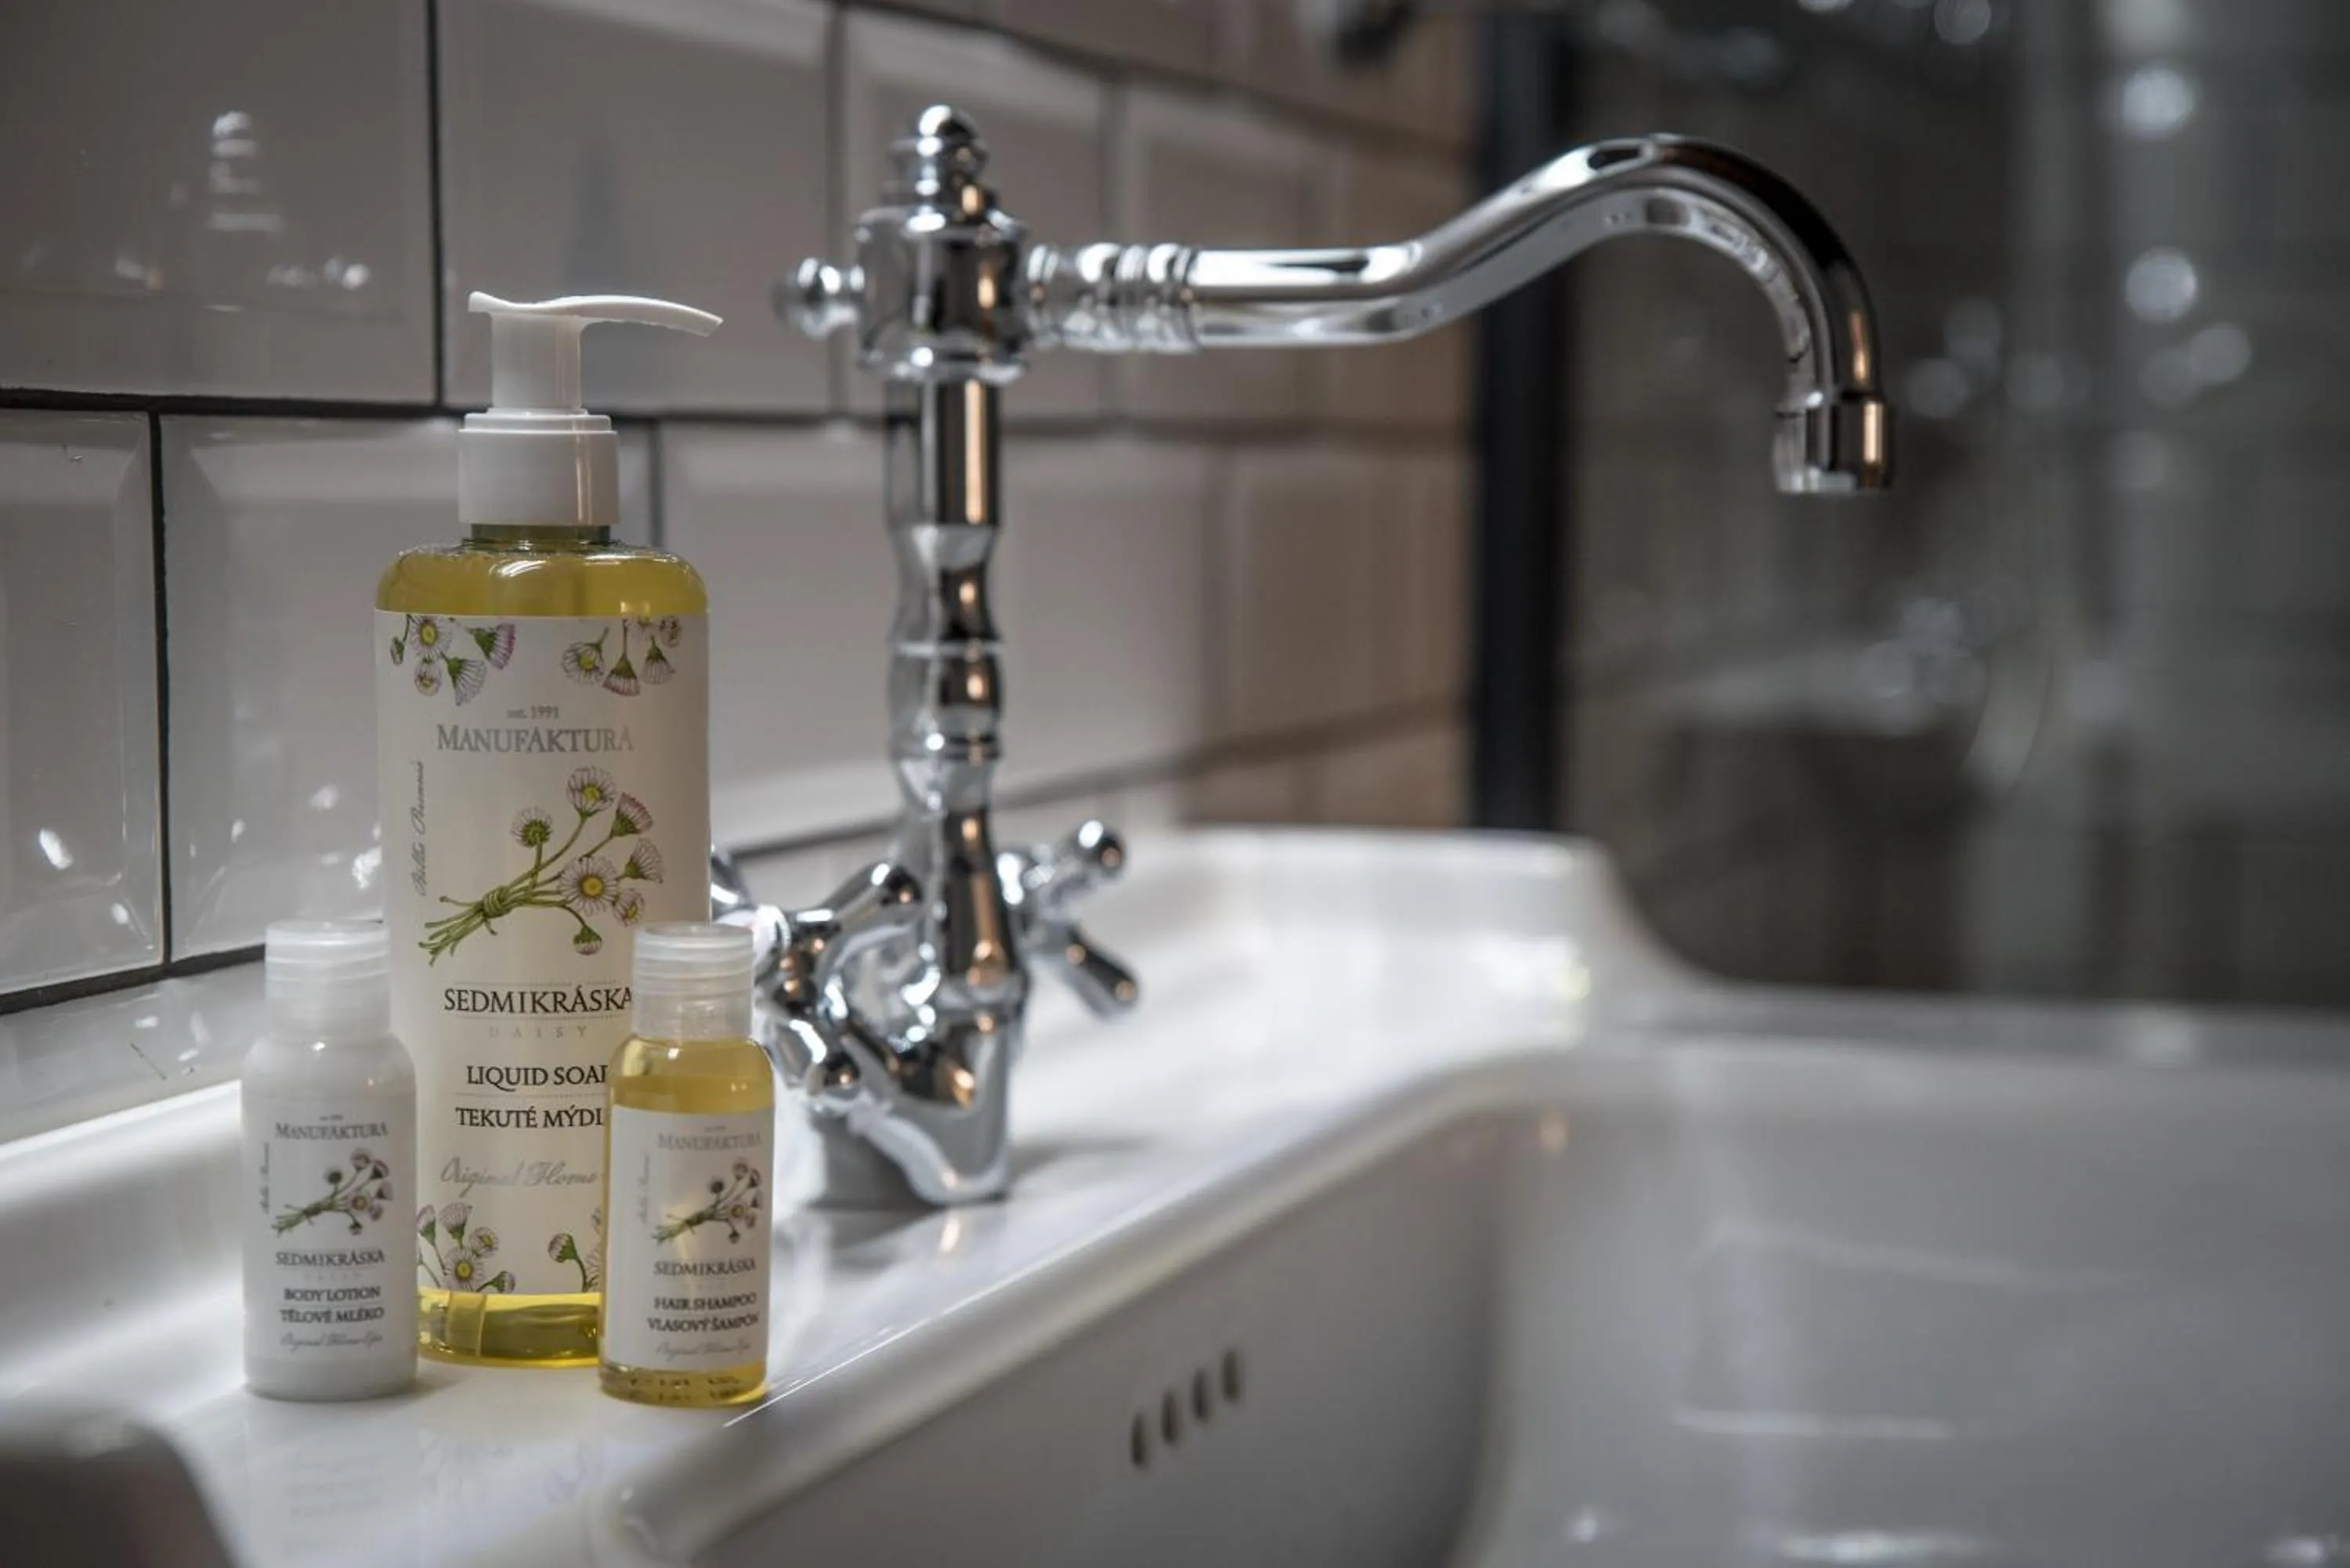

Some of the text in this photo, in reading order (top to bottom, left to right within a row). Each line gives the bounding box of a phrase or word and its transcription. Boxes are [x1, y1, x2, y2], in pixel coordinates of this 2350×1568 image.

[530, 705, 560, 720] 1991
[436, 724, 634, 753] MANUFAKTURA
[443, 984, 633, 1014] SEDMIKRÁSKA
[466, 1065, 548, 1093] LIQUID
[455, 1105, 538, 1129] TEKUTÉ
[284, 1285, 381, 1302] BODY LOTION
[653, 1296, 690, 1311] HAIR
